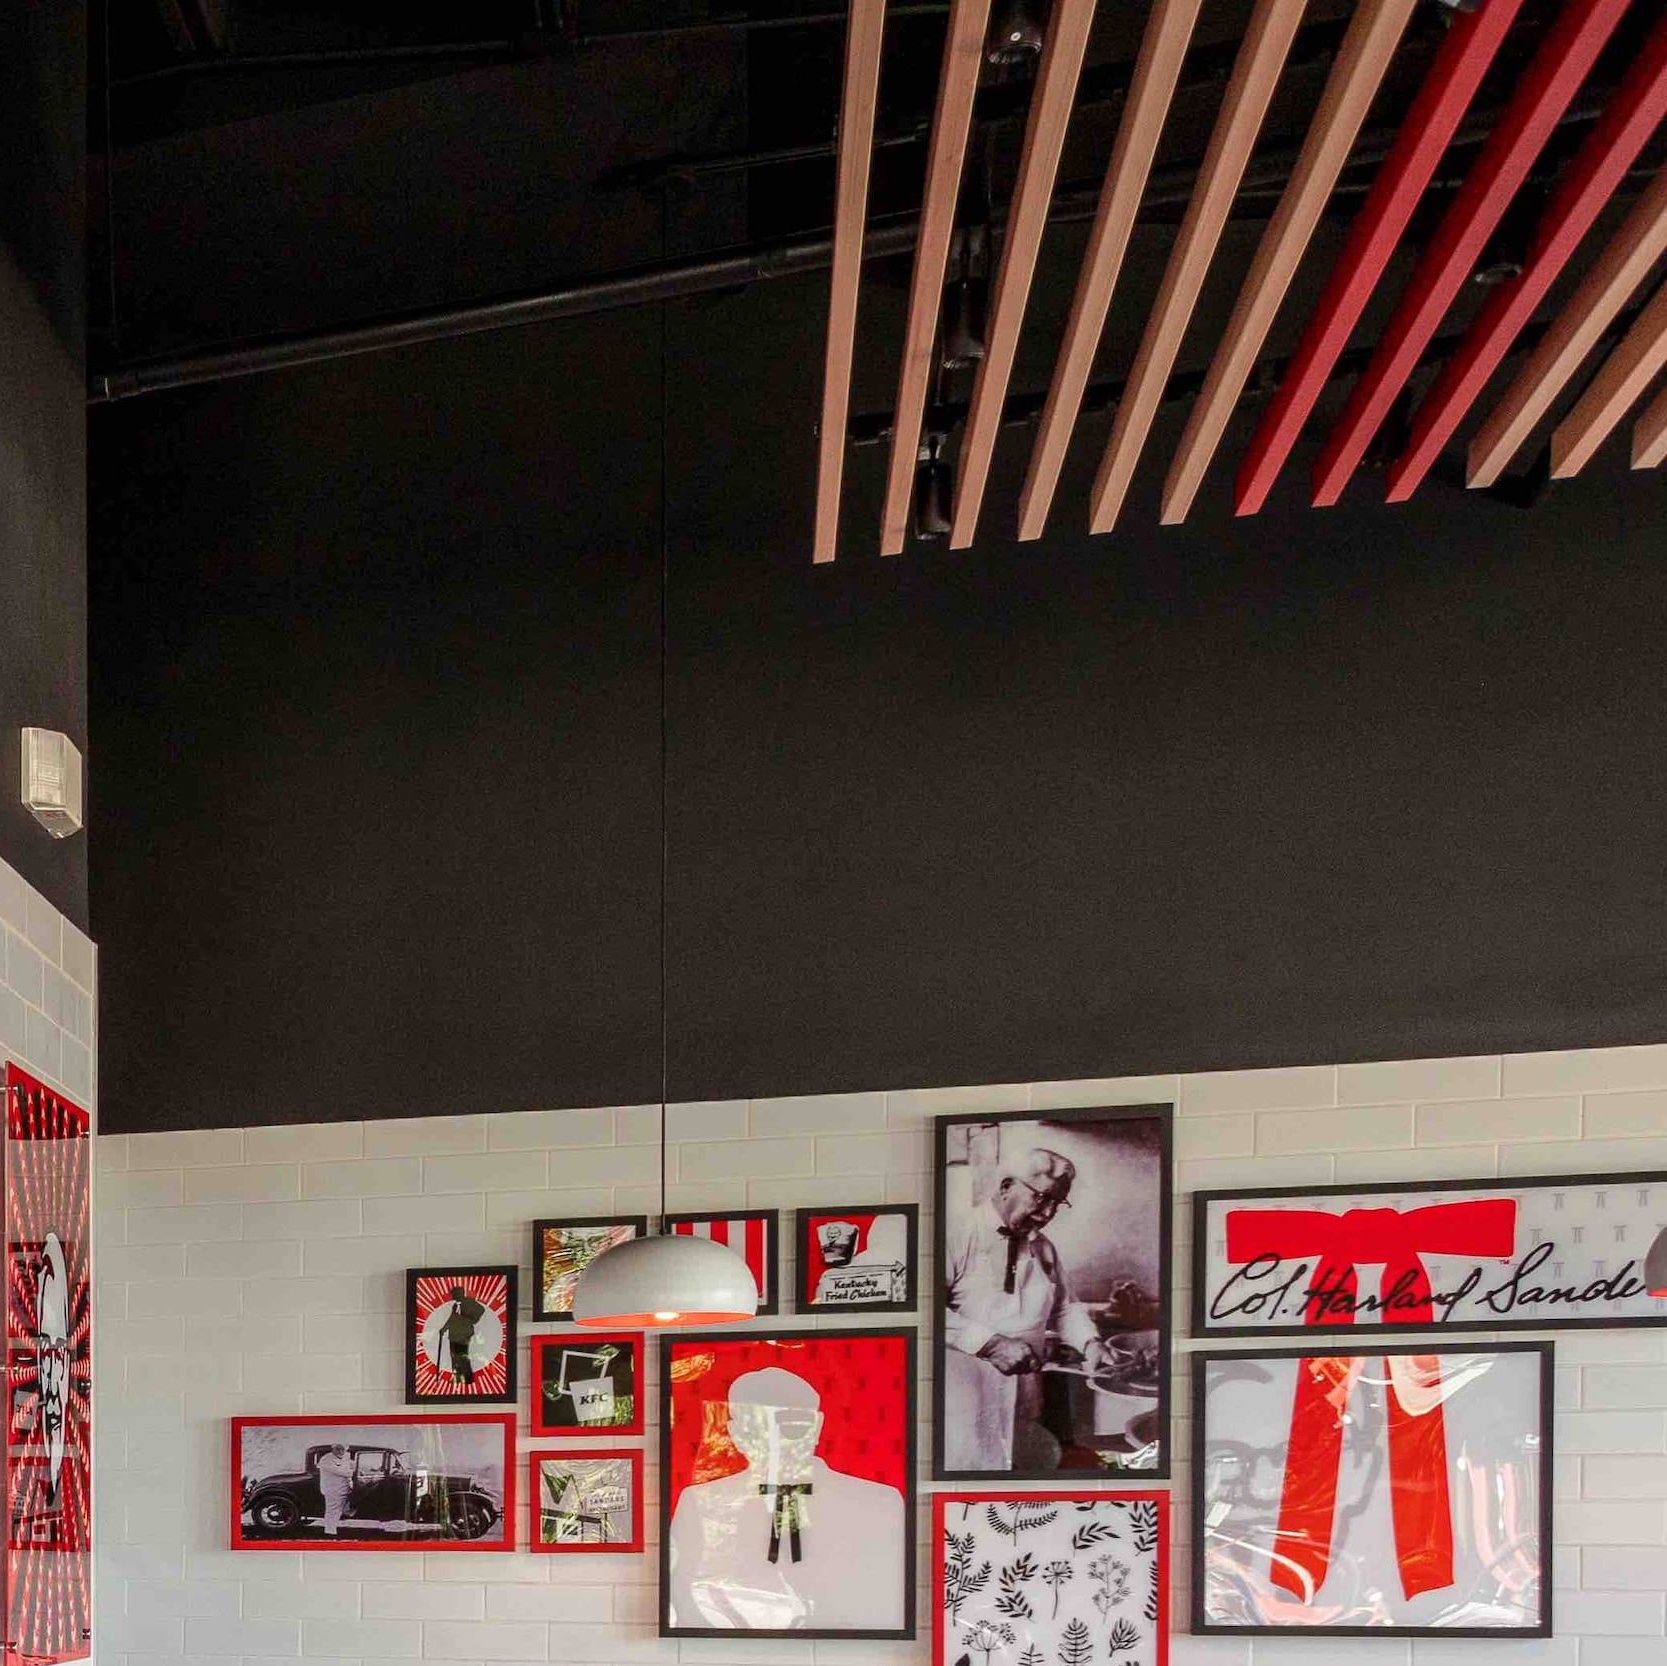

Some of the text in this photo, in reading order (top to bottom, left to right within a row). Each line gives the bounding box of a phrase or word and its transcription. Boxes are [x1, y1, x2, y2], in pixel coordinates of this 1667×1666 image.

[834, 1278, 878, 1289] Kentucky
[1209, 1242, 1650, 1322] Col. Harland Sande
[826, 1288, 887, 1301] Fried Chicken
[580, 1393, 609, 1406] KFC
